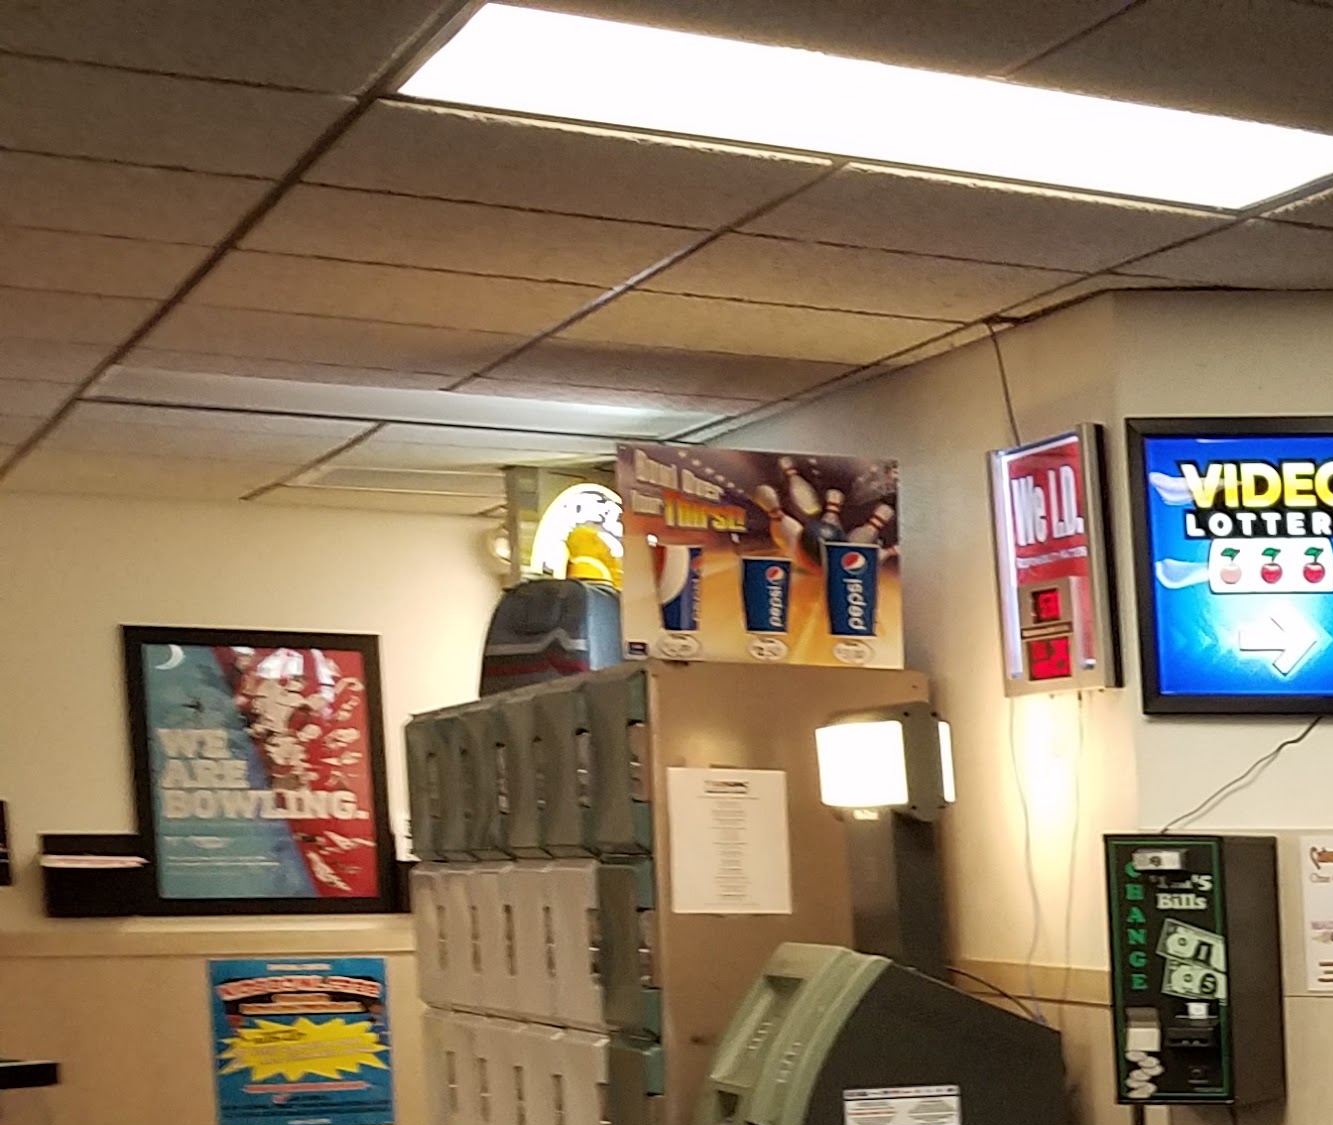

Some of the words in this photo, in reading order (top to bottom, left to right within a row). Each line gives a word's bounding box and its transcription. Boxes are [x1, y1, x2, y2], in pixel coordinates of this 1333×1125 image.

[1011, 475, 1048, 547] We
[158, 728, 233, 758] WE
[161, 758, 249, 789] ARE
[161, 789, 369, 820] BOWLING.
[1155, 893, 1208, 910] Bills
